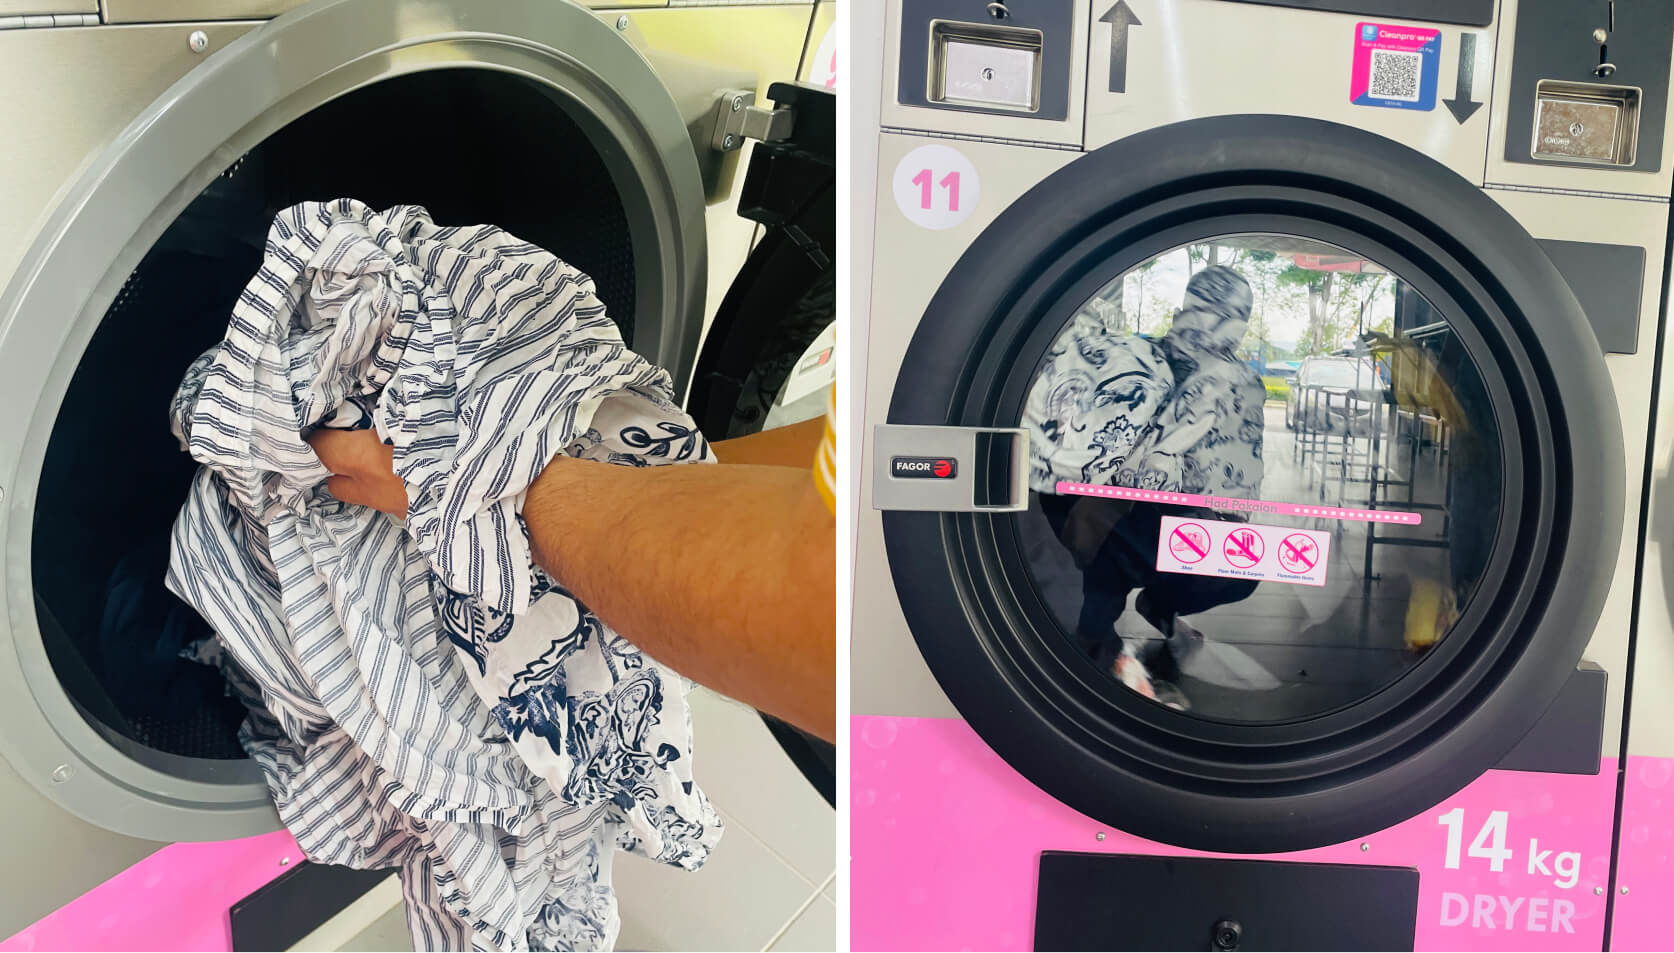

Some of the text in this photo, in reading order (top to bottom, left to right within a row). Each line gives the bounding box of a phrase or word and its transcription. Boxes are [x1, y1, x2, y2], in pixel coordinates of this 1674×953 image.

[1379, 30, 1415, 41] Cleanpro
[911, 168, 961, 212] 11
[896, 461, 931, 471] FAGOR
[1204, 497, 1278, 513] Had Pakaian
[1438, 807, 1582, 889] 14 kg
[1439, 891, 1576, 935] DRYER
